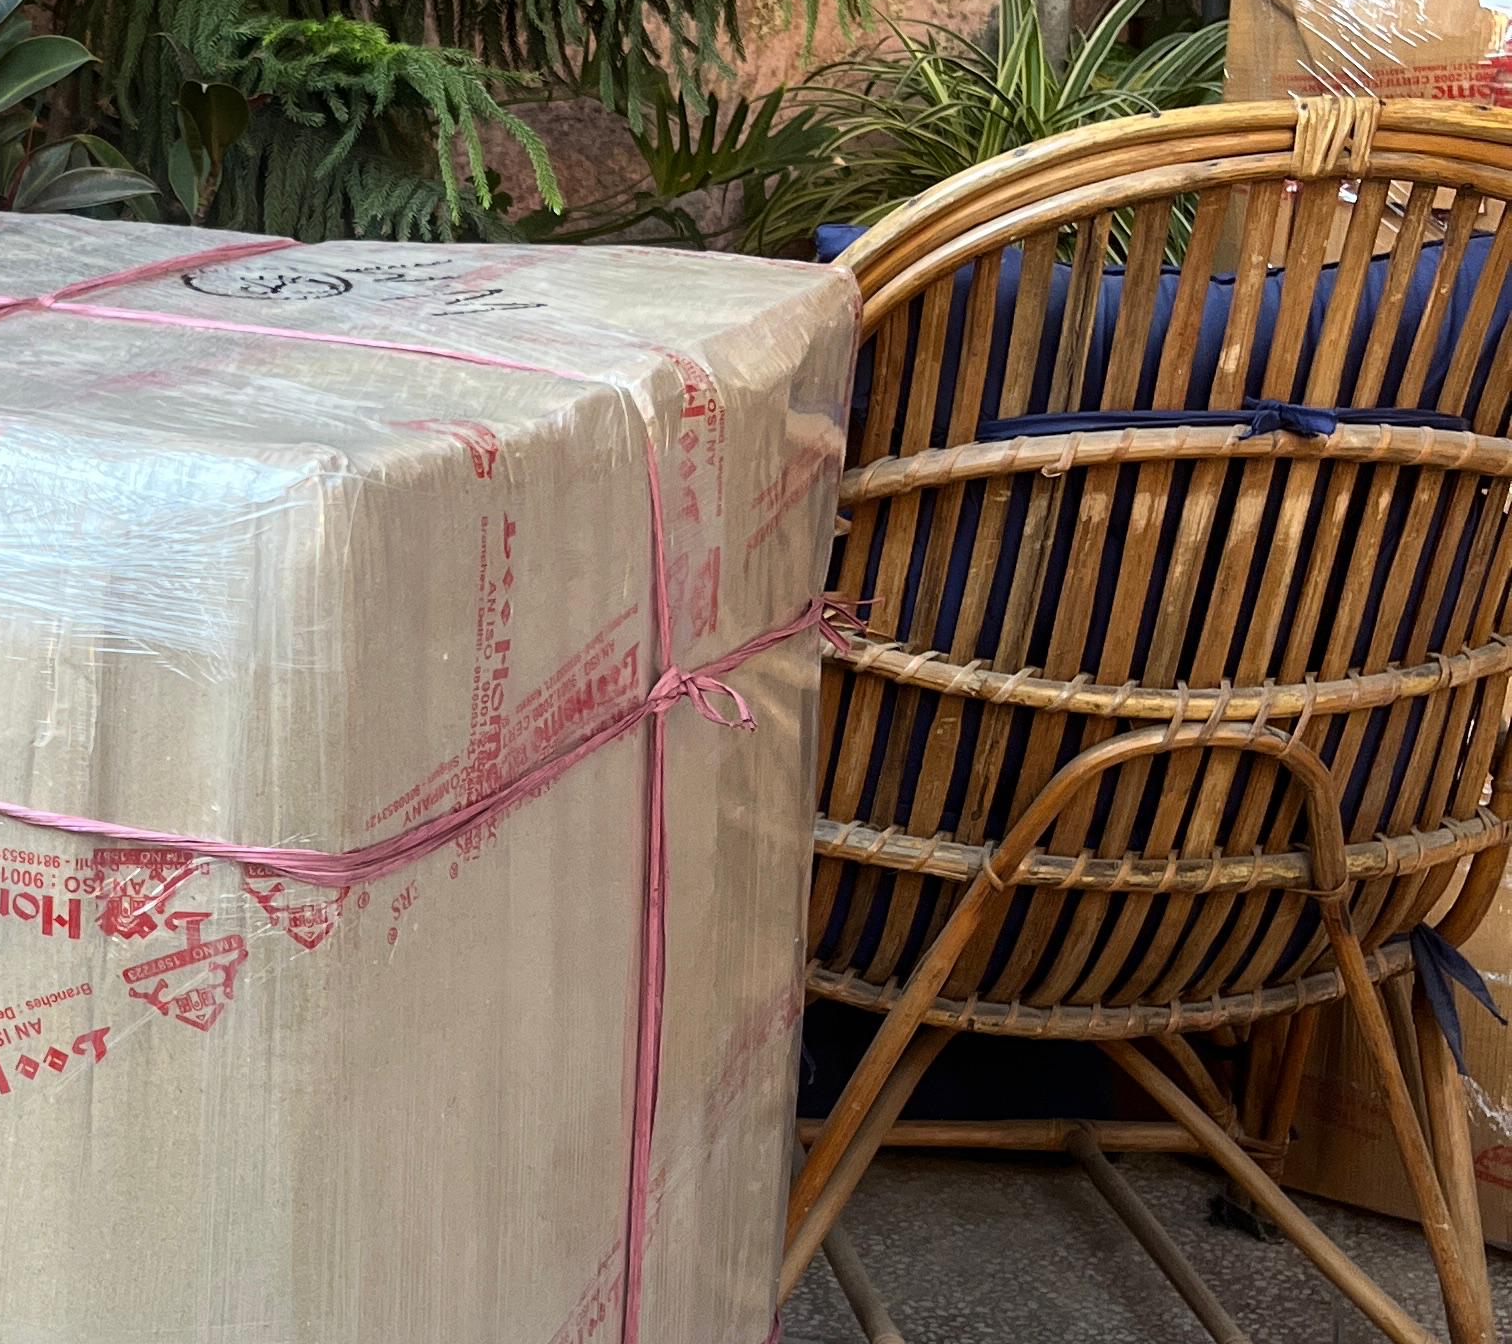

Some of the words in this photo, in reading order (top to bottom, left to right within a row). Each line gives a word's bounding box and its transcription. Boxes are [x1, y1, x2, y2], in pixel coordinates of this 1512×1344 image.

[486, 582, 496, 612] AN
[483, 621, 493, 660] ISO
[190, 943, 213, 959] NO
[24, 983, 93, 1012] Branches
[13, 1018, 43, 1039] AN
[16, 1026, 111, 1081] Lee
